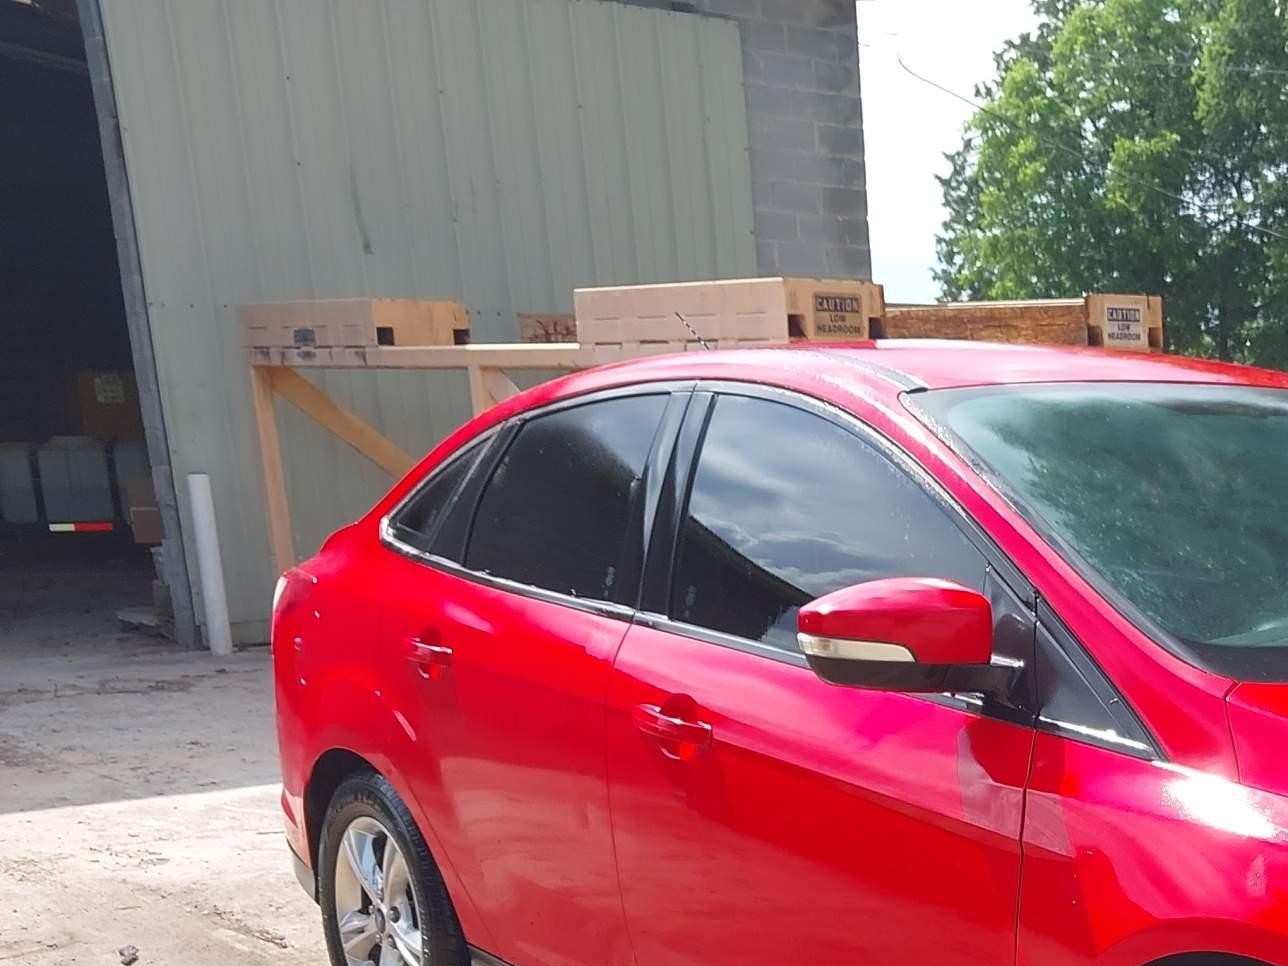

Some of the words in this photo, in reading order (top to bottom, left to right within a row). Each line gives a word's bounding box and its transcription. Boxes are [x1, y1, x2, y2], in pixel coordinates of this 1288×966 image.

[815, 296, 860, 312] CAUTION
[829, 313, 846, 323] LOW
[1107, 308, 1140, 321] CAUTION
[816, 324, 861, 335] HEADROOM
[1117, 323, 1130, 331] LOW
[1107, 332, 1141, 341] HEADROOM
